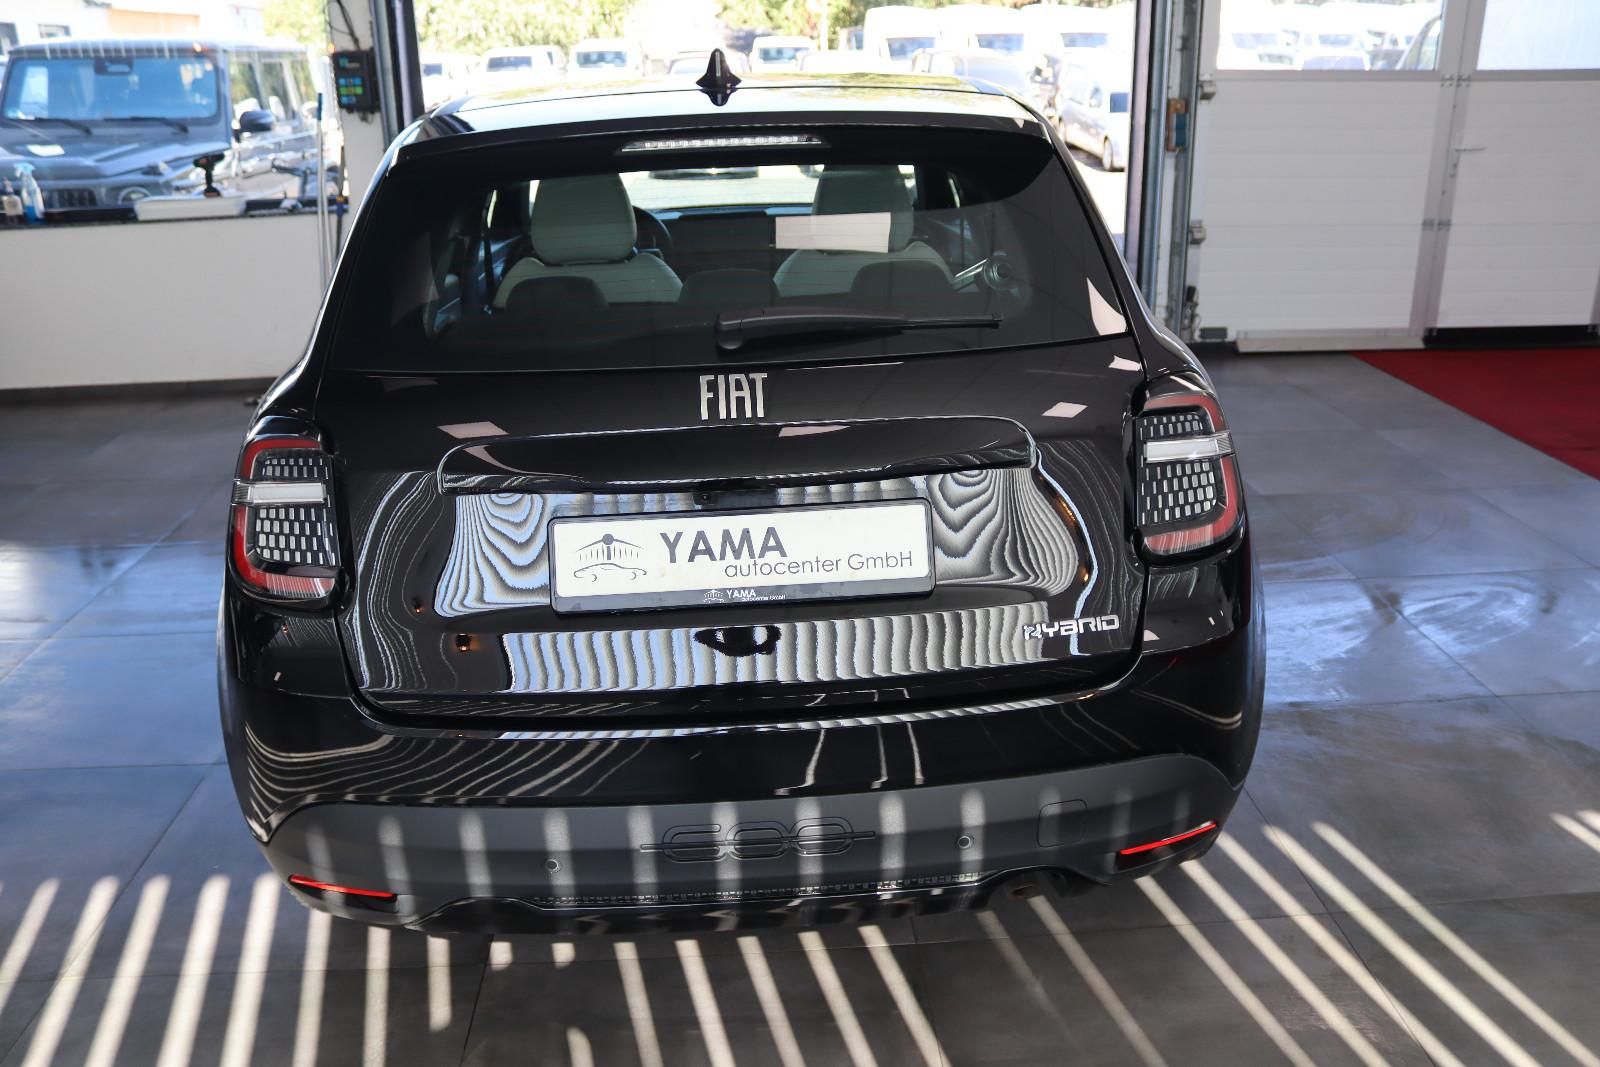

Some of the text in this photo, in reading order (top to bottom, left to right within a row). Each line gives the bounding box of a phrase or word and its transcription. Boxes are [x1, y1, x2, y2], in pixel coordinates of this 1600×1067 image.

[699, 373, 768, 421] FIAT
[659, 526, 788, 564] YAMA
[725, 550, 913, 578] autocenter GmbH
[726, 589, 757, 599] YAMA
[1023, 614, 1120, 640] HYBRID
